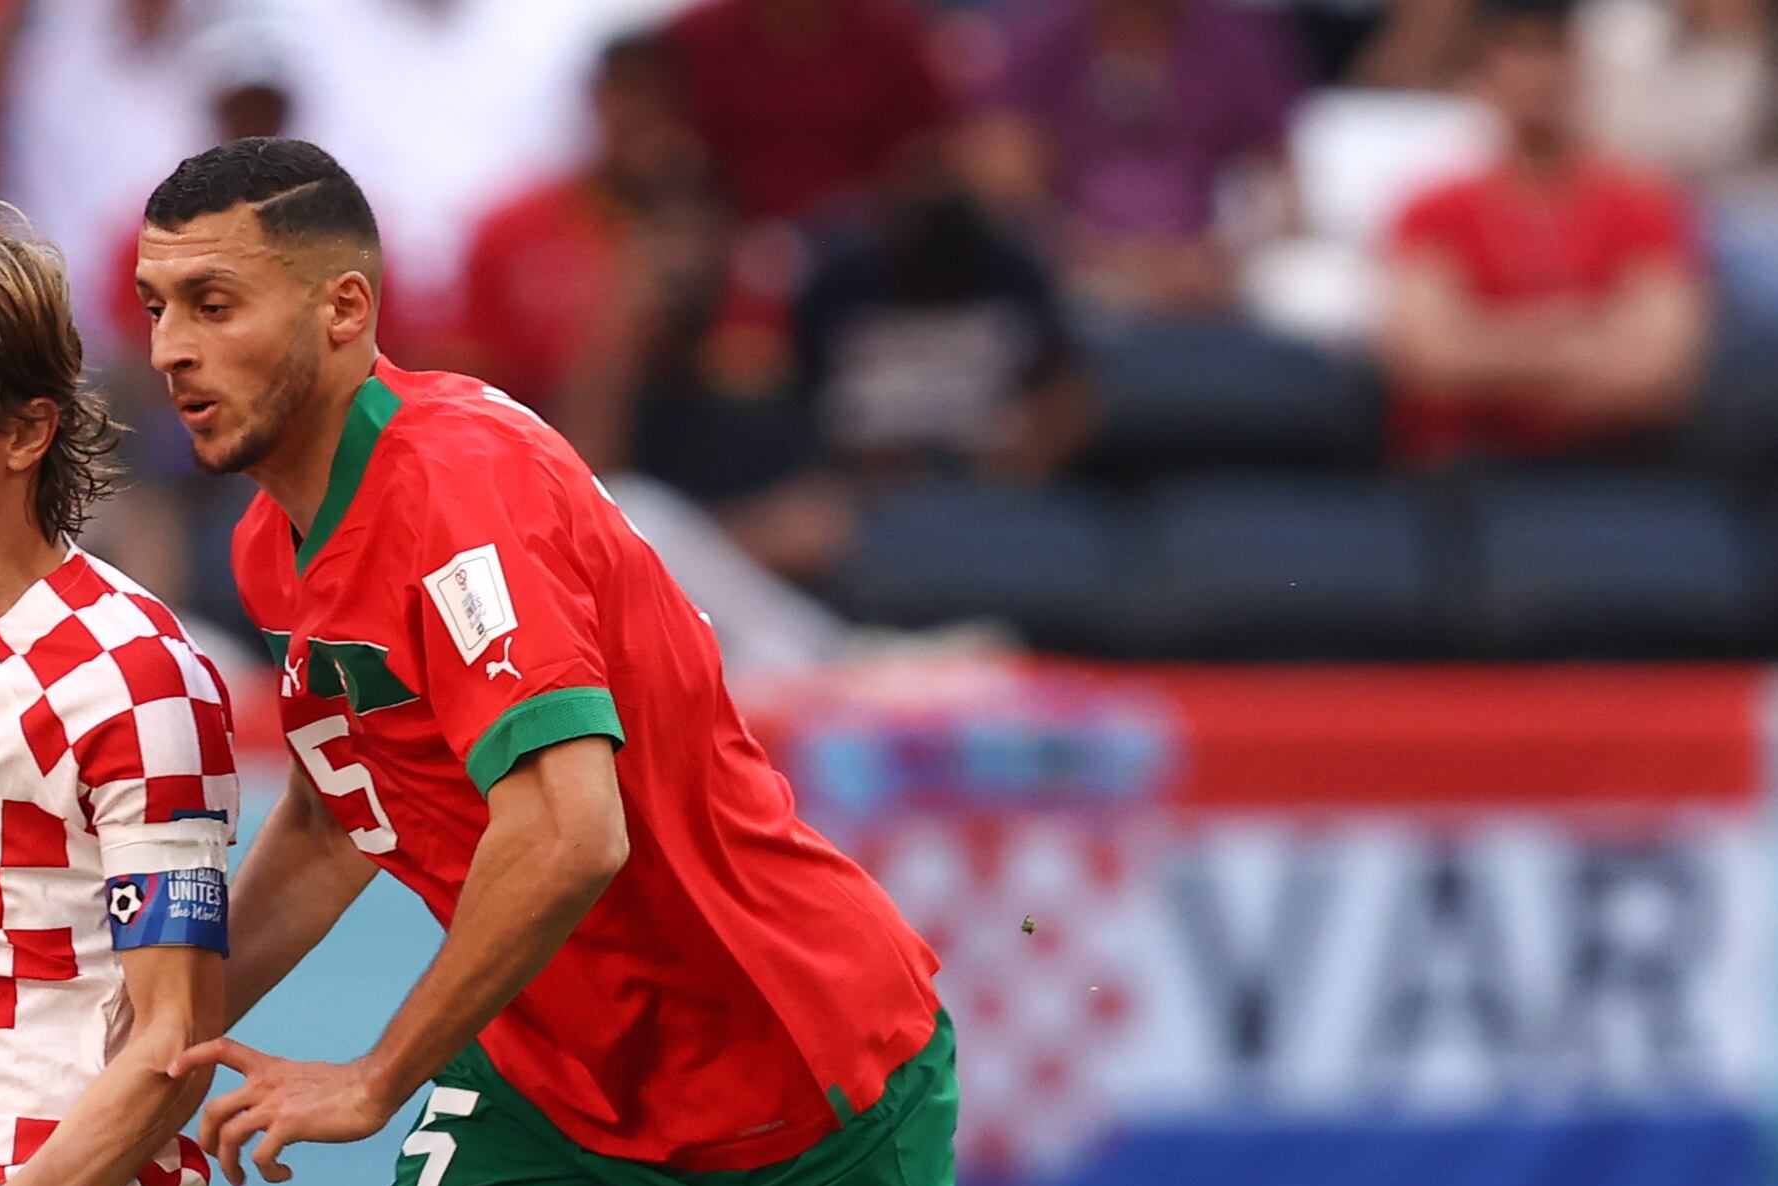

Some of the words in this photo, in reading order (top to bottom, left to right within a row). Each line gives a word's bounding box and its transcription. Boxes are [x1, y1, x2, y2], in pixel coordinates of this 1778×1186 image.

[286, 714, 398, 855] 5
[167, 880, 221, 905] UNITES
[168, 901, 191, 918] the
